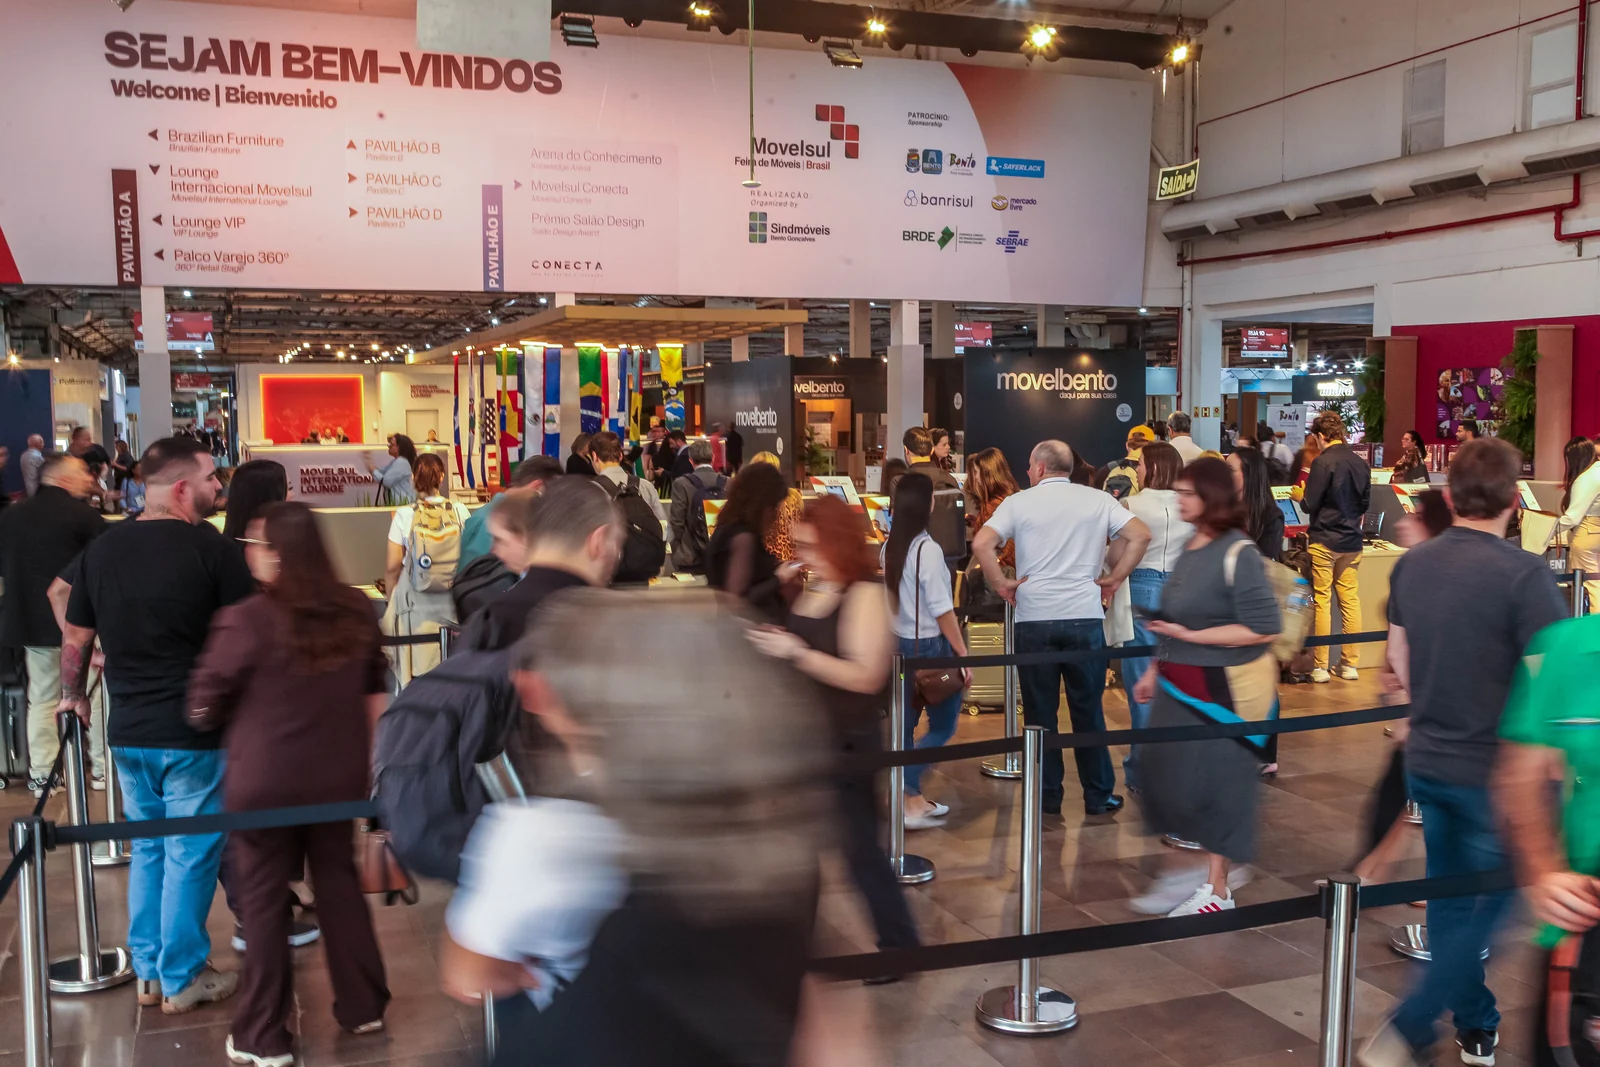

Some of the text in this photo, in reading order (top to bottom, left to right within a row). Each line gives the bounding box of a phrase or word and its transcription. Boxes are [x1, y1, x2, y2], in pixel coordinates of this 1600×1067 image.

[104, 31, 271, 77] SEJAM
[110, 79, 210, 101] Welcome
[225, 84, 337, 109] Bienvenido
[168, 129, 284, 147] Brazilian Furniture
[169, 144, 240, 154] Brazilian Furniture
[365, 139, 440, 154] PAVILHÃO B
[752, 137, 830, 158] Movelsul
[531, 148, 662, 165] Arena do Conhecimento
[758, 158, 769, 167] de
[771, 158, 800, 168] Móveis
[806, 160, 830, 170] Brasil
[170, 165, 219, 181] Lounge
[366, 172, 442, 187] PAVILHÃO C
[170, 181, 312, 197] Internacional Movelsul
[531, 180, 628, 195] Movelsul Conecta
[1161, 170, 1187, 196] SAÍDA
[171, 194, 288, 206] Movelsul International Lounge
[750, 199, 788, 208] Organized
[921, 193, 973, 208] banrisul
[367, 206, 442, 220] PAVILHÃO D
[532, 212, 645, 228] Prêmio Salão Design
[172, 215, 246, 229] Lounge VIP
[771, 223, 830, 235] Sindmóveis
[117, 191, 136, 282] PAVILHÃO A
[174, 228, 218, 238] VIP Lounge
[903, 230, 936, 242] BRDE
[486, 205, 499, 288] PAVILHÃO E
[996, 237, 1029, 246] SEBRAE
[174, 250, 210, 262] Palco
[213, 251, 255, 266] Varejo
[532, 260, 603, 270] CONECTA
[197, 264, 219, 272] Retail
[221, 264, 244, 273] Stage
[794, 381, 844, 393] velbento
[997, 368, 1117, 391] movelbento
[1059, 391, 1076, 400] daqui
[736, 406, 777, 427] movelbento
[300, 476, 377, 485] INTERNATION
[301, 485, 344, 493] LOUNGE
